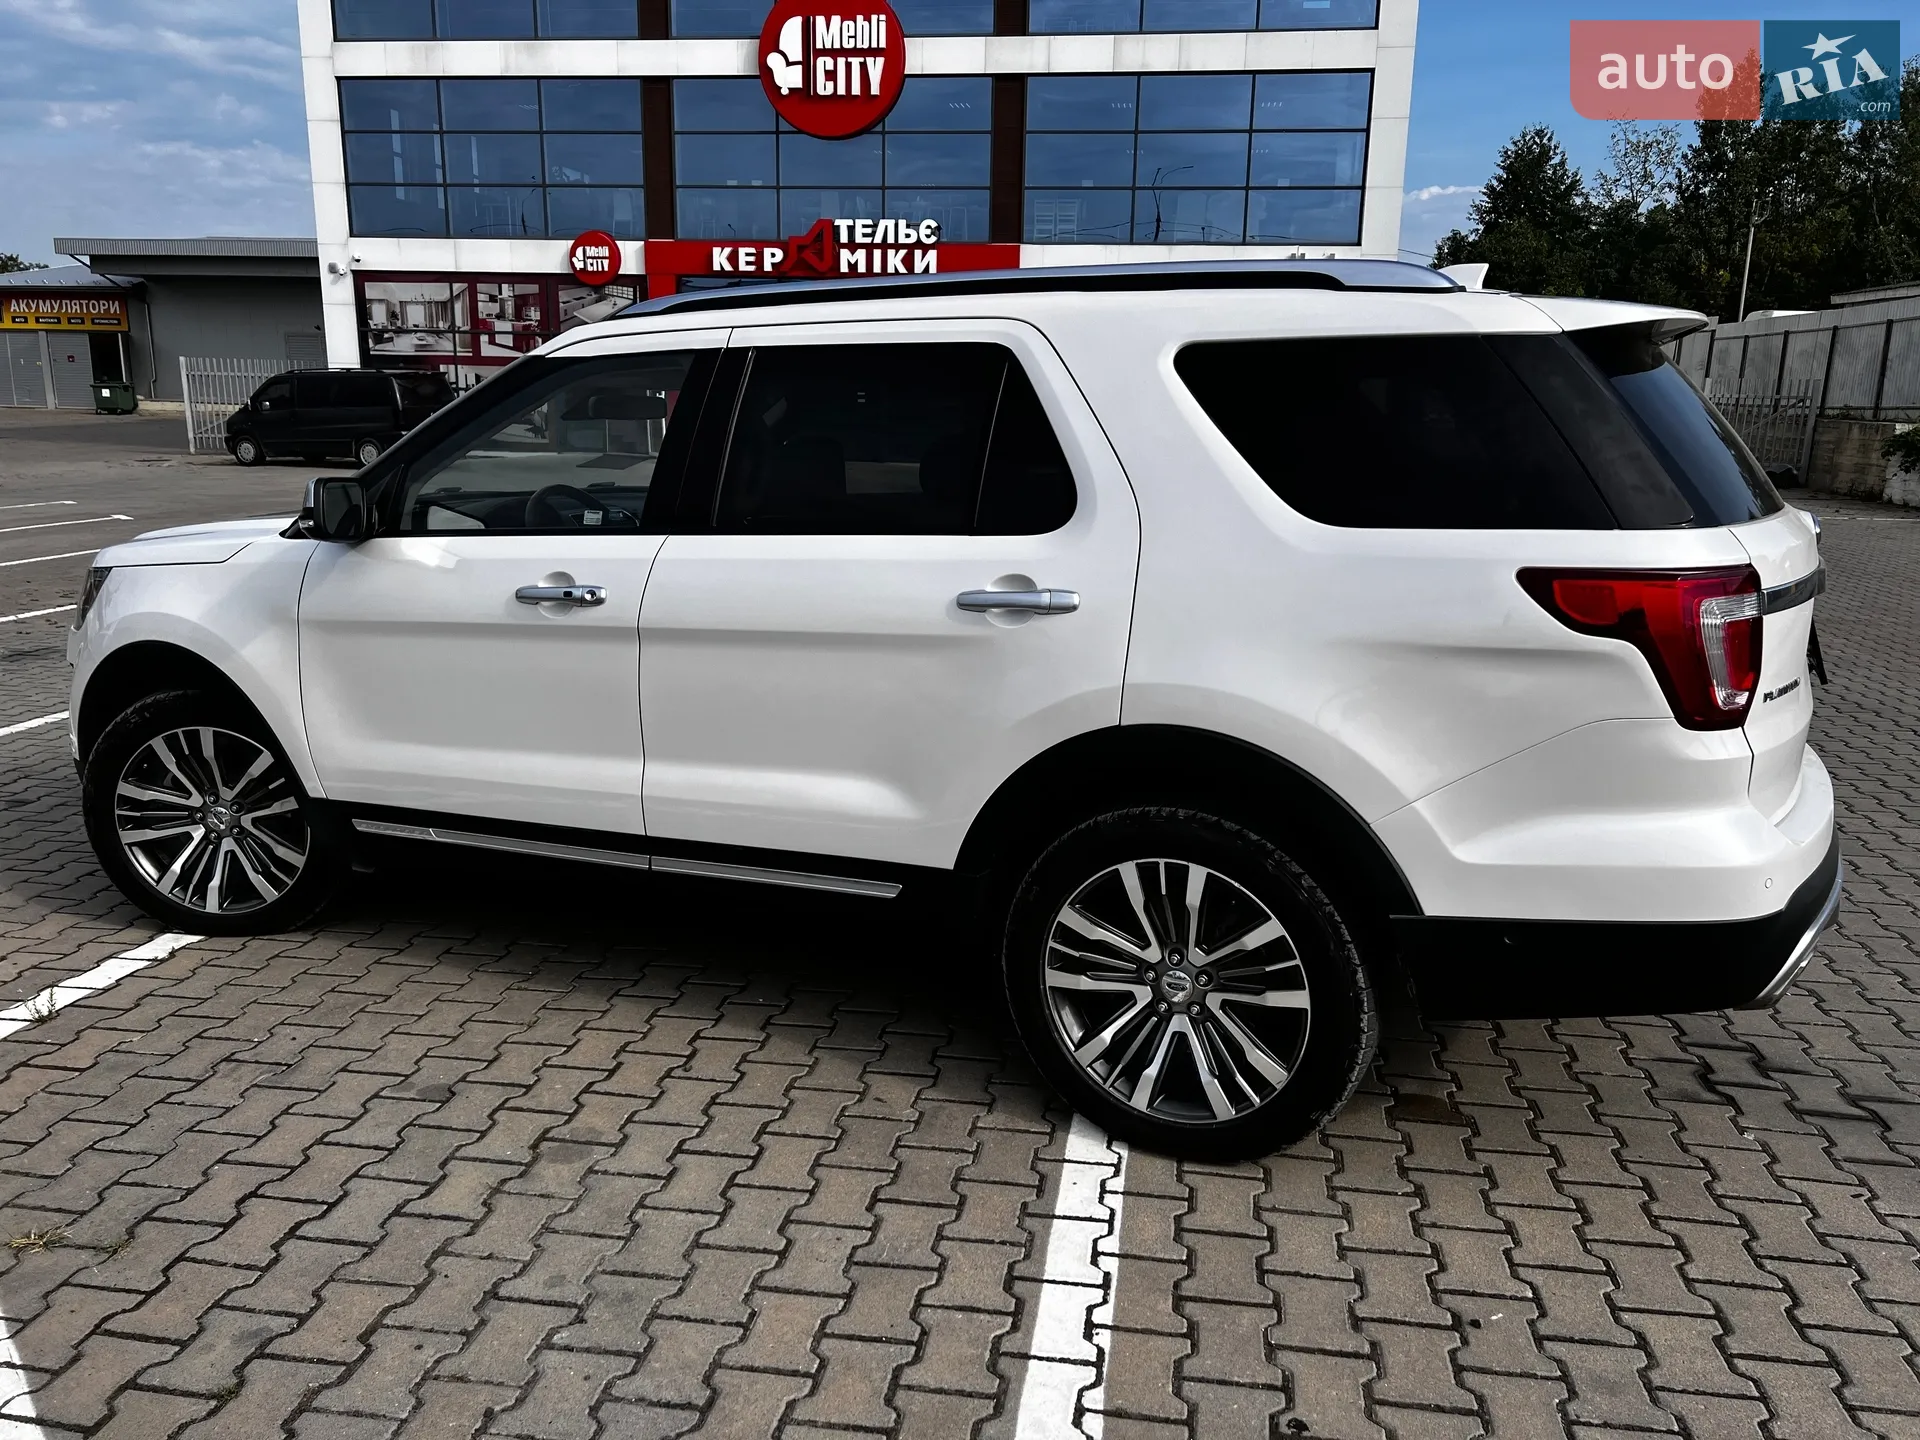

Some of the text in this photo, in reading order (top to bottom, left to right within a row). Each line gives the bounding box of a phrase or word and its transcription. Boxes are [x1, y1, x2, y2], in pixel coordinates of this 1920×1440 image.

[815, 14, 887, 49] Mebli
[815, 56, 885, 96] CITY
[586, 246, 610, 257] Mebli
[587, 258, 610, 272] CITY
[10, 298, 121, 314] АКУМУЛЯТОРИ
